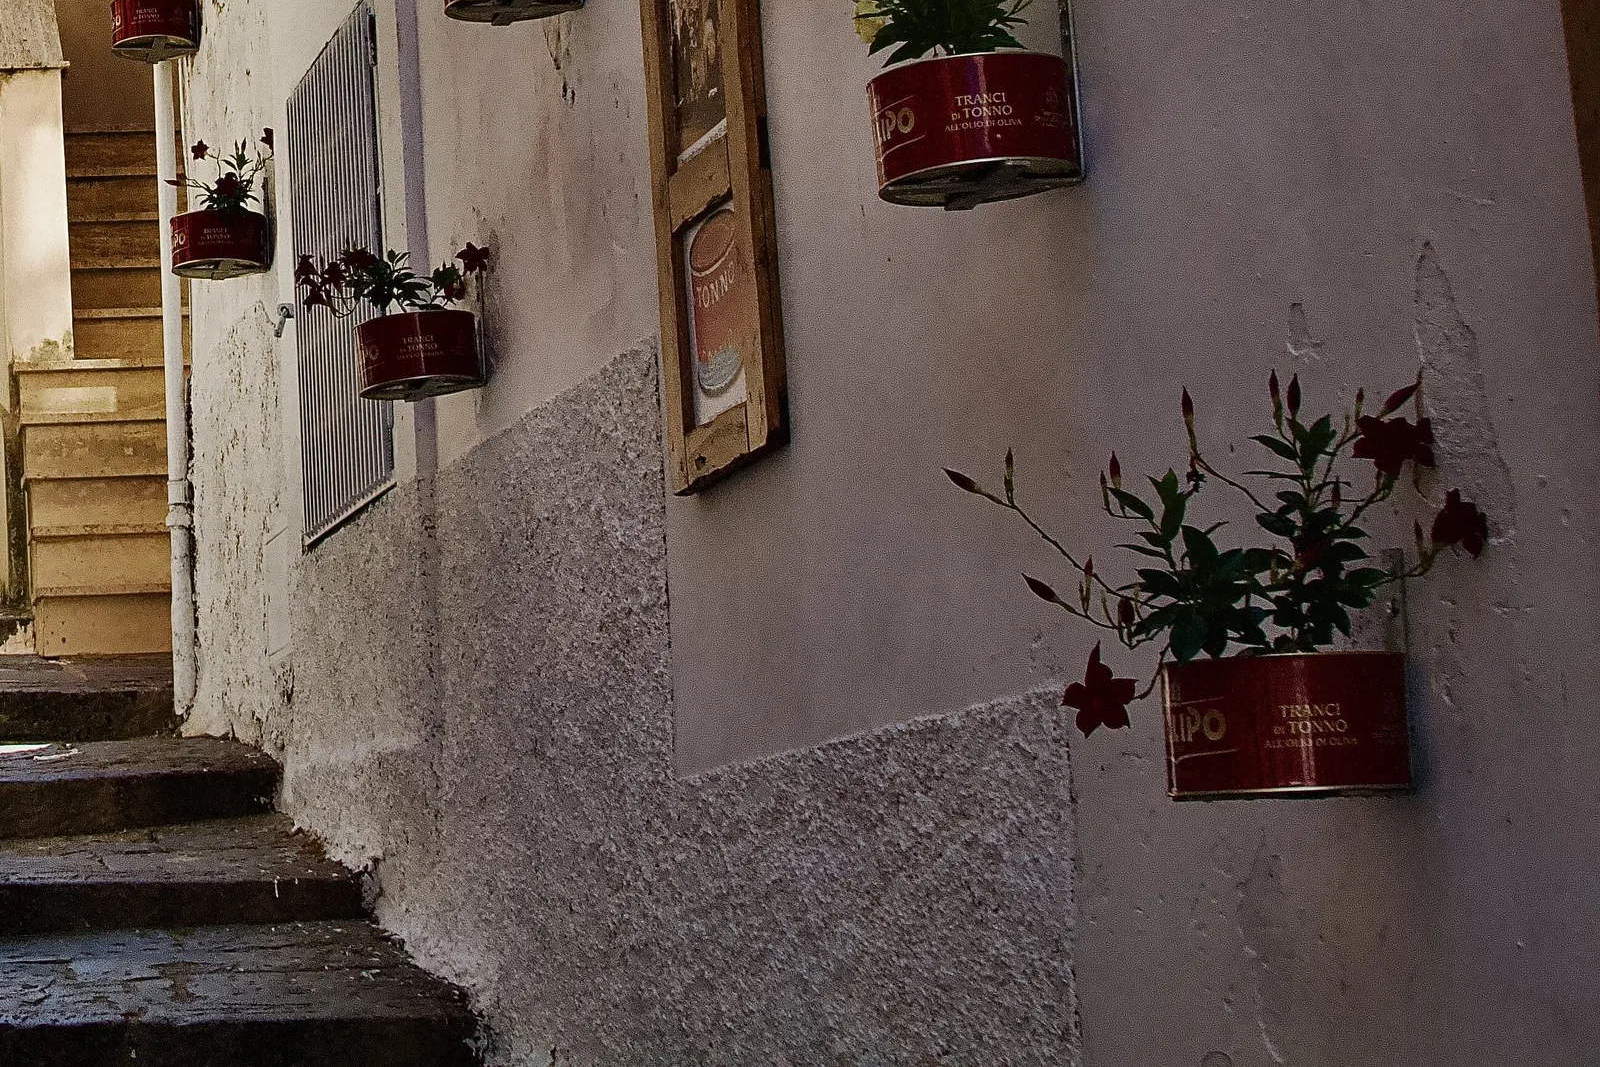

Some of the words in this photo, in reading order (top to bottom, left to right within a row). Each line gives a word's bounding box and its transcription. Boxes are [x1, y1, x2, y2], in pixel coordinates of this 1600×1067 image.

[955, 92, 1006, 107] TRANCI
[951, 112, 961, 121] DI
[963, 104, 1013, 119] TONNO
[986, 119, 996, 127] DI
[997, 118, 1023, 127] OLIVA
[402, 334, 434, 344] TRANCI
[407, 342, 438, 352] TONNO
[1278, 703, 1341, 718] TRANCI
[1287, 719, 1348, 734] TONNO
